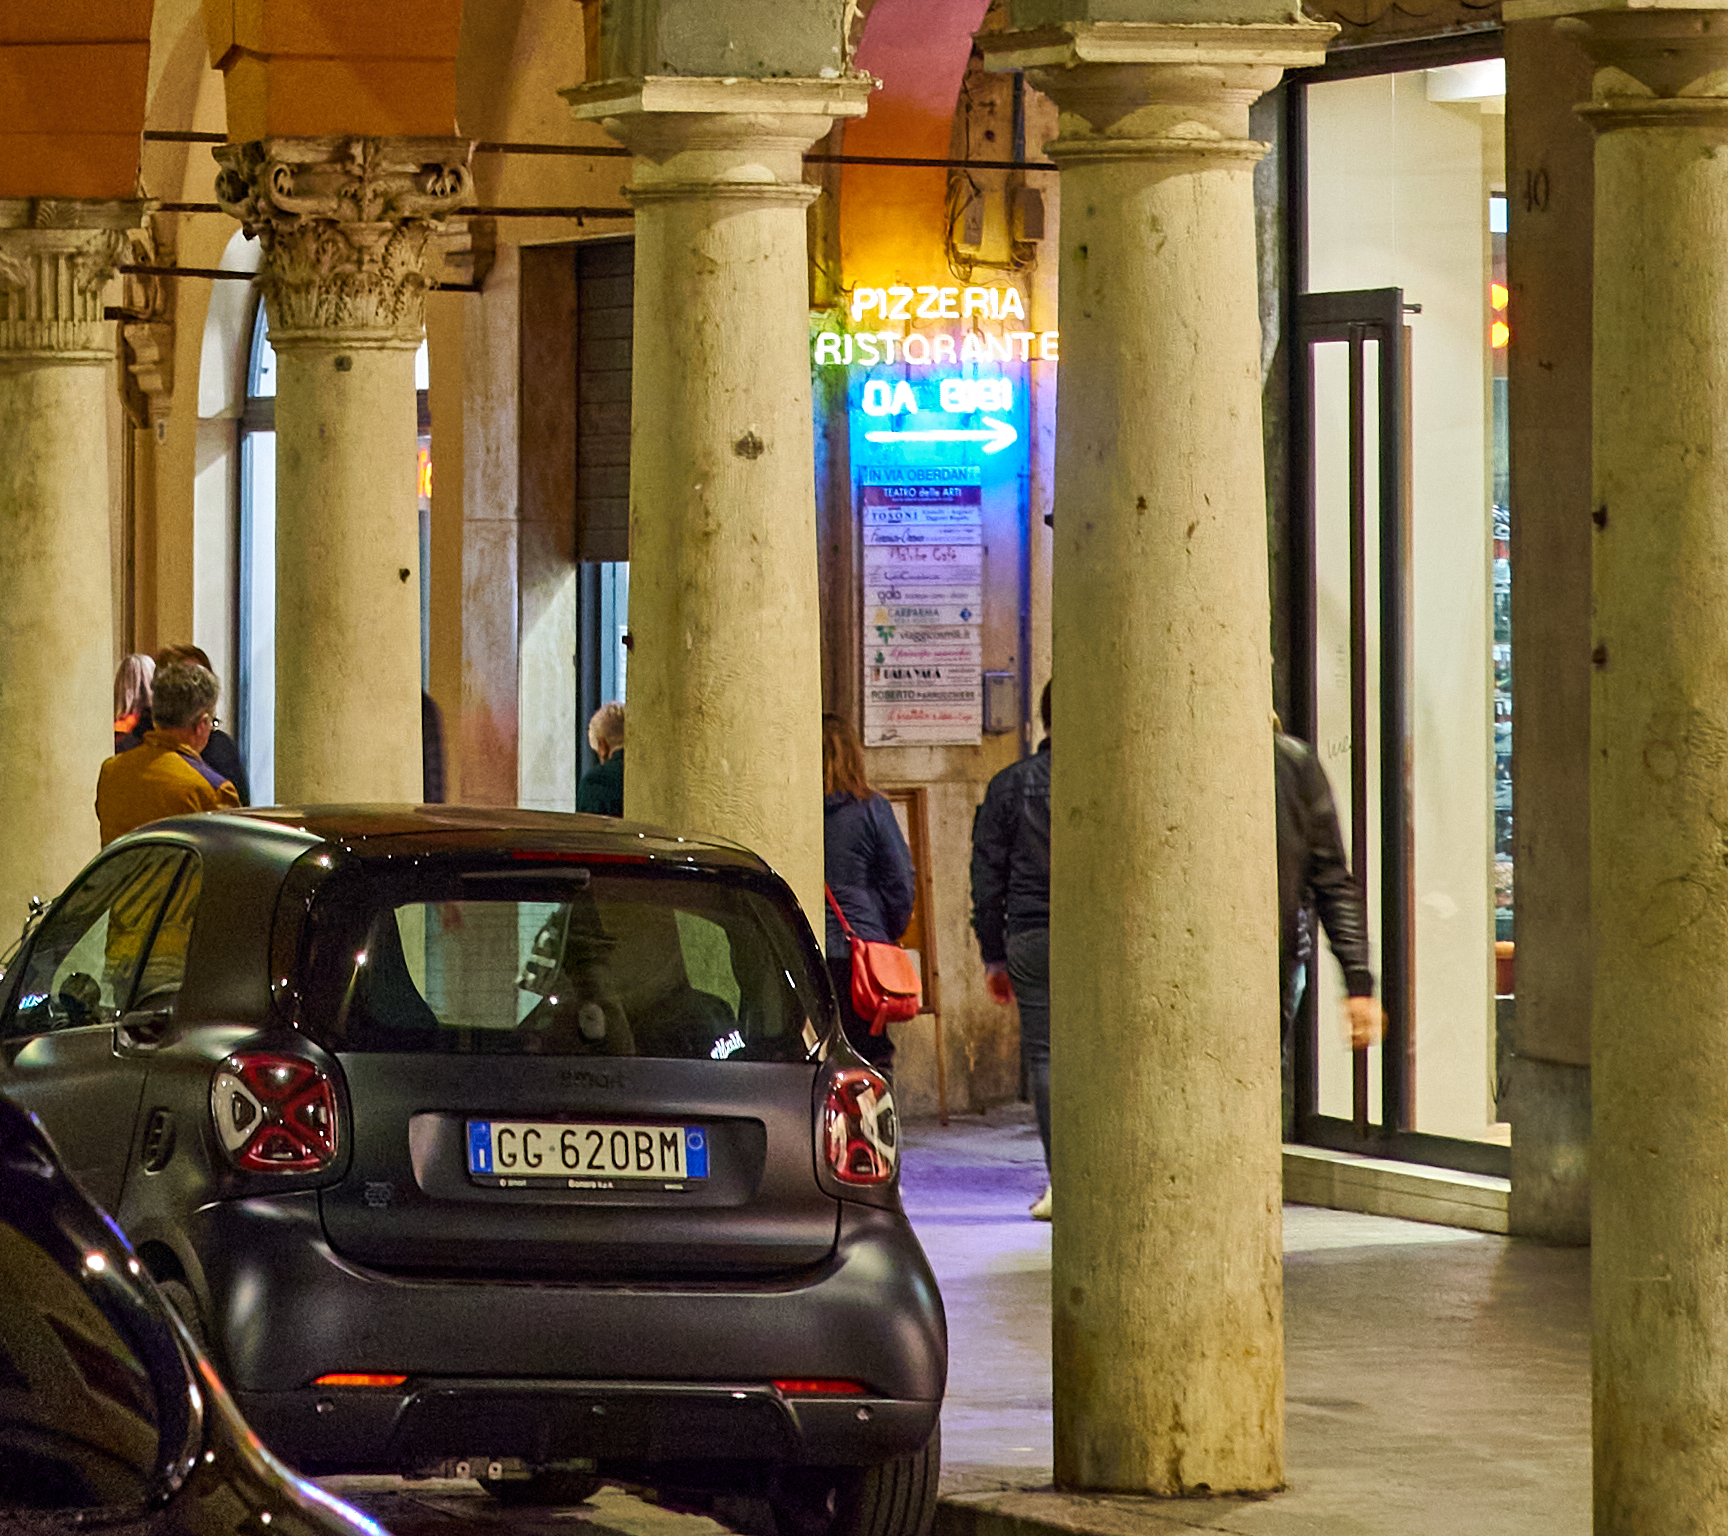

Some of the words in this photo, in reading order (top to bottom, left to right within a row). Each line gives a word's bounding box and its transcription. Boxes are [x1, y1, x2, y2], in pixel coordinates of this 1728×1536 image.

[851, 286, 1025, 321] PIZZERIA
[814, 331, 1060, 365] RISTORANTE
[861, 380, 918, 416] DA
[869, 469, 881, 481] IN
[884, 469, 903, 481] VIA
[907, 469, 968, 481] OBERDAN
[884, 487, 917, 497] TEATRO
[942, 487, 962, 497] ARTI
[872, 511, 918, 521] TOSONI
[872, 690, 915, 699] ROBERTO
[496, 1128, 543, 1168] GG
[559, 1129, 681, 1172] 620BM
